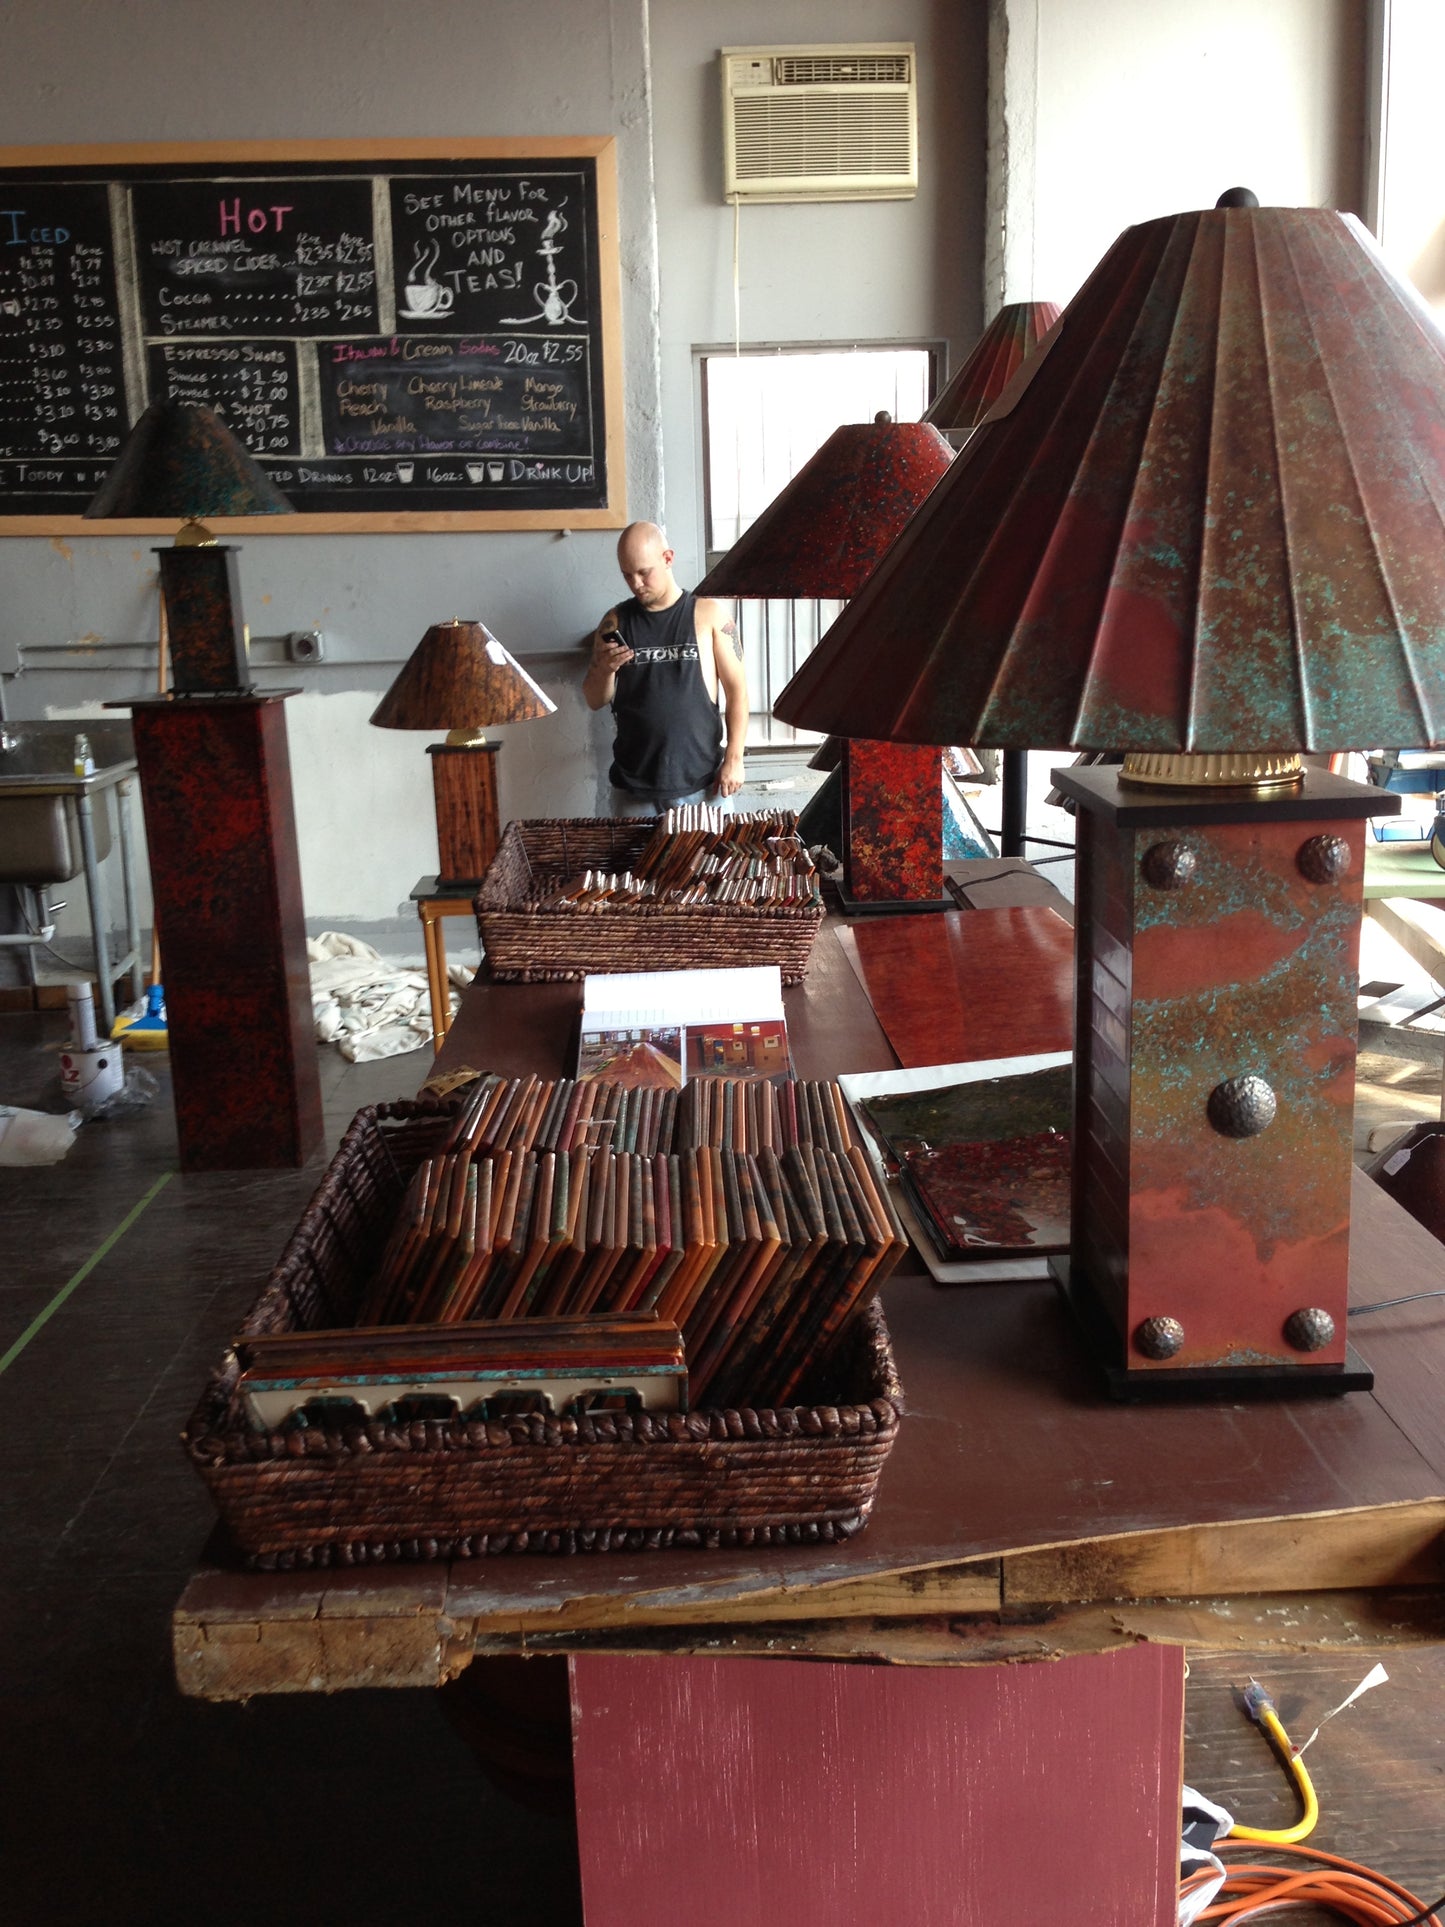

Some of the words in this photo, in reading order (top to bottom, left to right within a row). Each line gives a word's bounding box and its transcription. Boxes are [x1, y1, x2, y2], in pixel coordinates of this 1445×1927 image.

[403, 193, 444, 215] SEE
[453, 183, 511, 204] MENU
[220, 198, 293, 236] HOT
[426, 212, 476, 232] OTHER
[451, 226, 516, 248] OPTIONS
[467, 247, 506, 266] AND
[444, 261, 523, 294] TEAS!
[402, 339, 454, 361] Cream
[542, 340, 583, 364] $2.55
[525, 376, 564, 400] Mango
